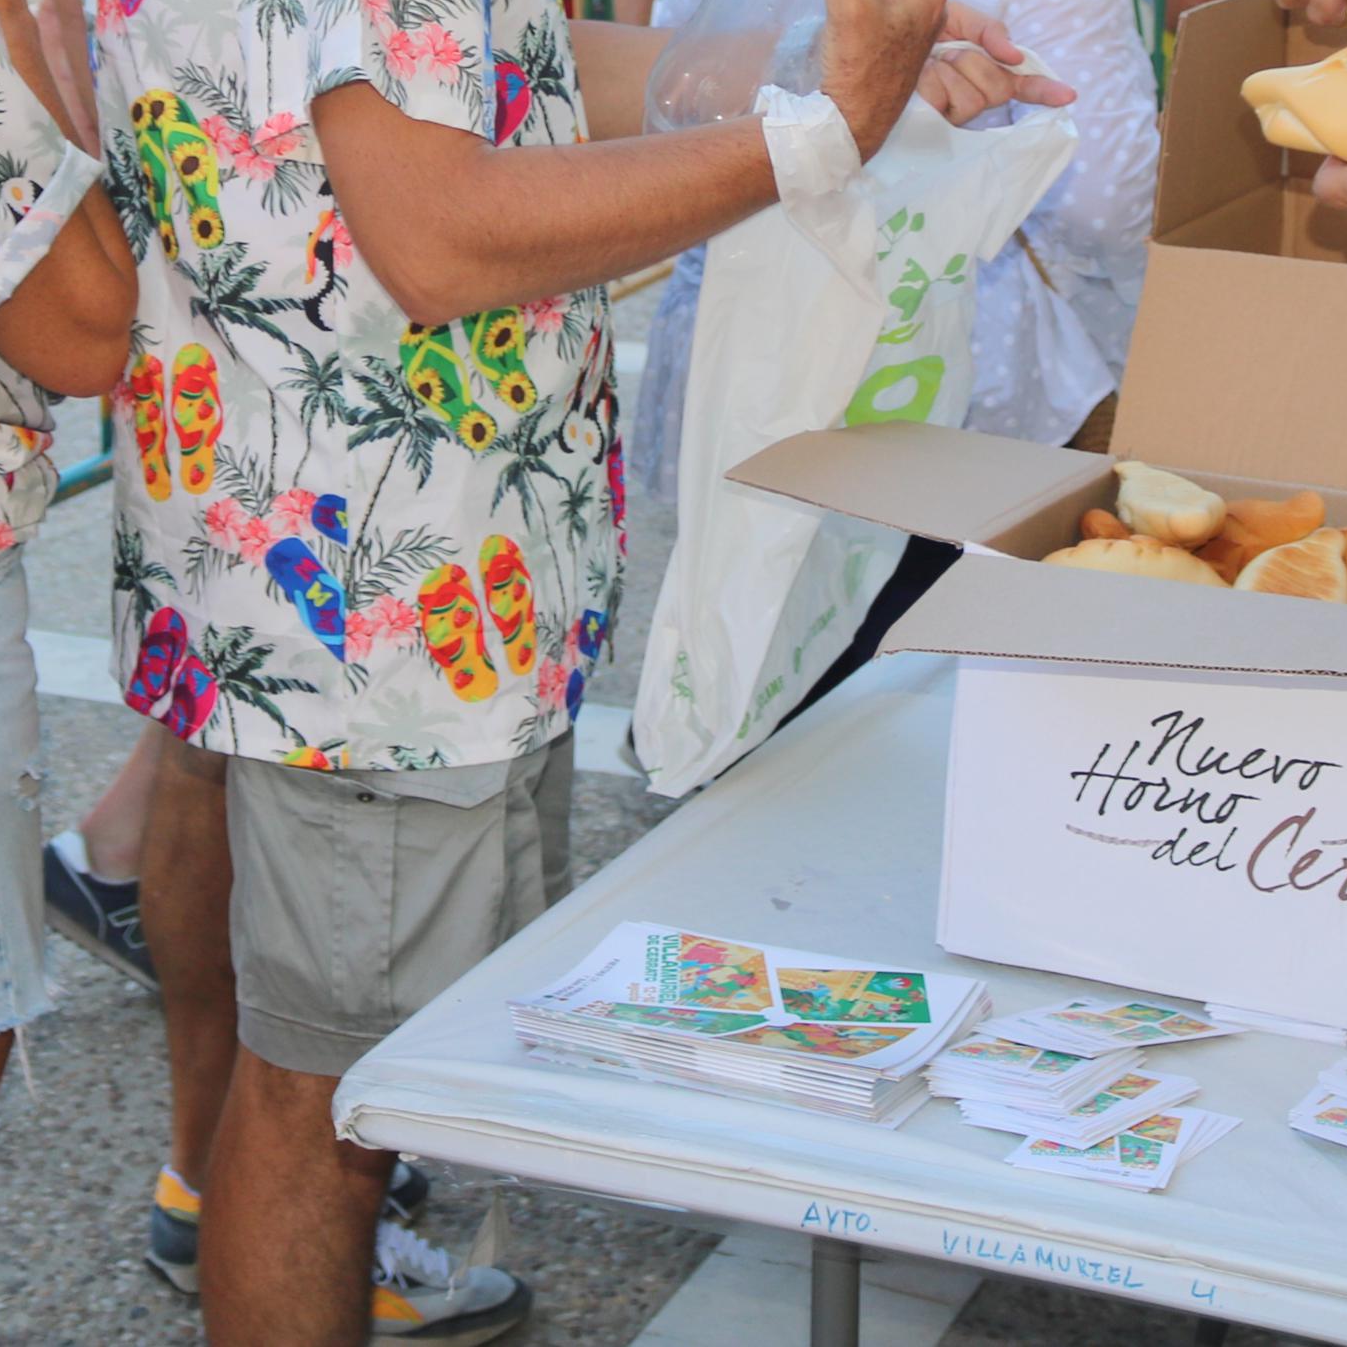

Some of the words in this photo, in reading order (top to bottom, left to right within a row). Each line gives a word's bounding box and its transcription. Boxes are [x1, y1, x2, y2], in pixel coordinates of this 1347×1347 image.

[1147, 709, 1343, 791] Nuevo
[1070, 740, 1261, 825] Horno
[1151, 827, 1239, 872] del
[644, 946, 659, 982] CERRATO
[647, 934, 660, 946] DE
[659, 934, 680, 1003] VILLAMURIEL
[942, 1229, 1145, 1290] VILLAMURIEL
